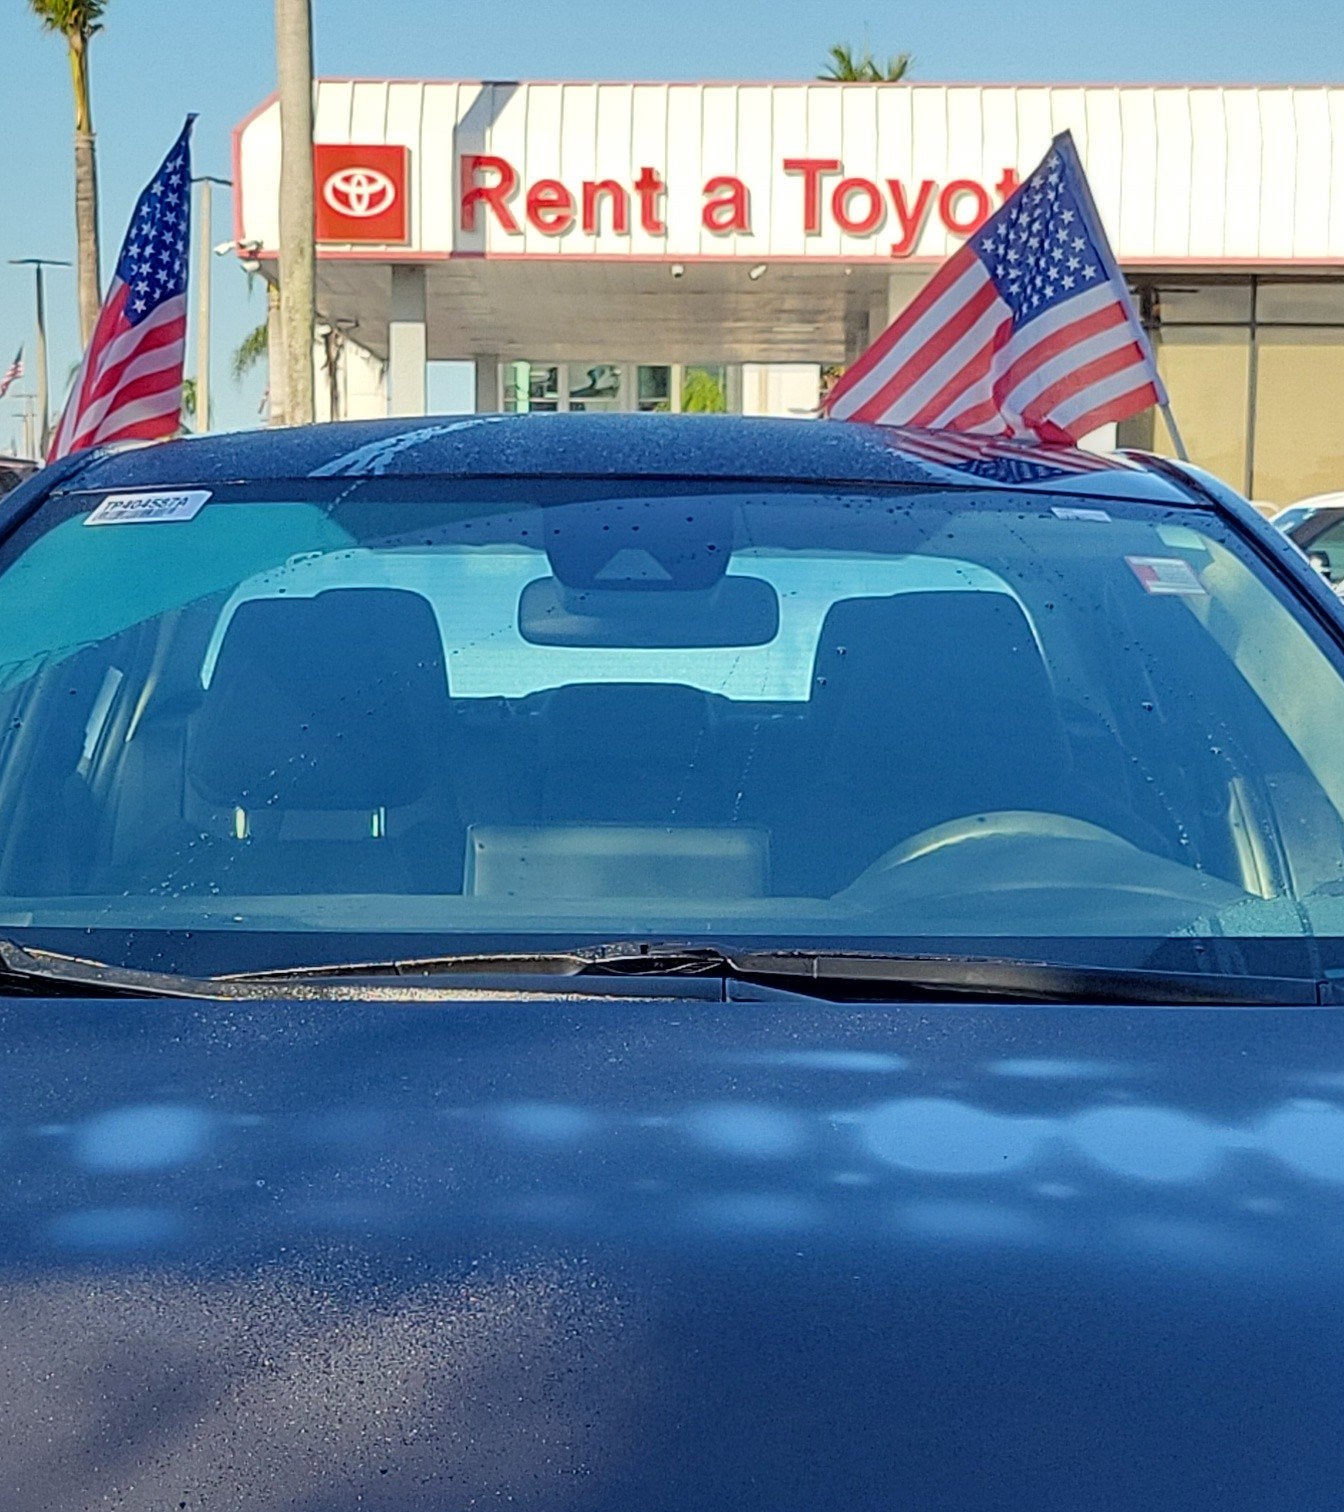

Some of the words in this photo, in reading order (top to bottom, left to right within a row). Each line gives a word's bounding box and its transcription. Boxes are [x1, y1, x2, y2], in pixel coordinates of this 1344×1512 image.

[460, 153, 664, 235] Rent
[701, 174, 752, 236] a
[783, 156, 1021, 258] Toyot
